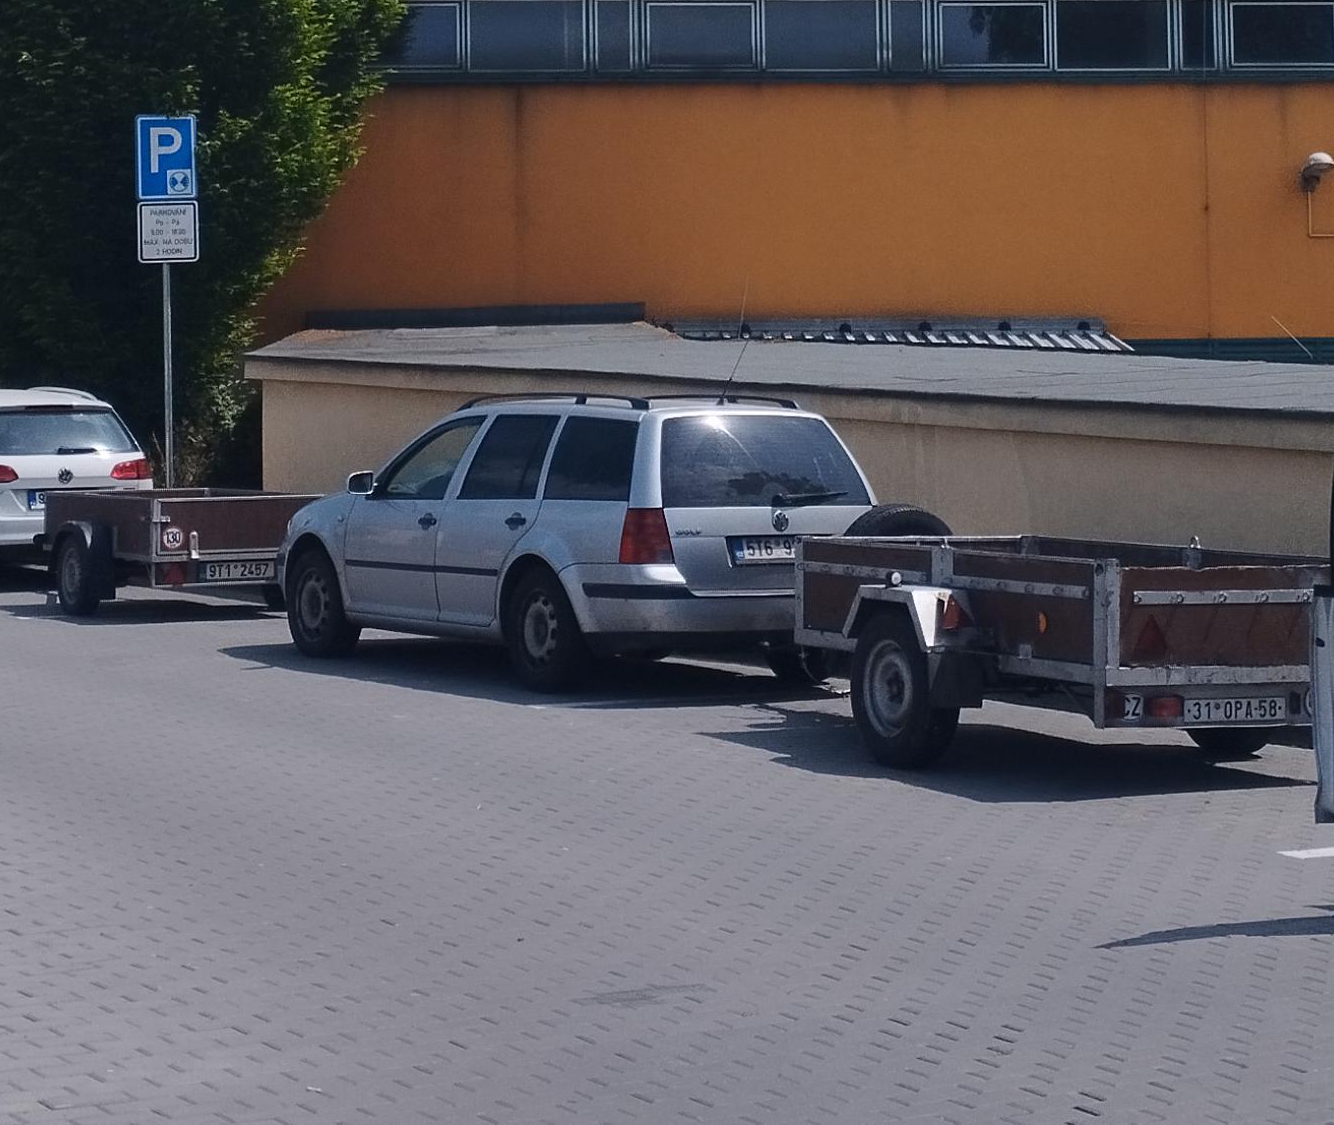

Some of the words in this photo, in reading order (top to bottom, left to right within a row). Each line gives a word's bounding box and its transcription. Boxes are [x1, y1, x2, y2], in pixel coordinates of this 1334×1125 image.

[150, 127, 182, 173] P
[149, 208, 186, 216] PARKOVÁNÍ
[162, 238, 173, 246] NA
[162, 247, 183, 255] HODIN
[166, 531, 181, 544] 130
[747, 540, 774, 557] 5T6
[209, 564, 231, 578] 9T1
[240, 562, 269, 577] 2457
[1193, 701, 1211, 720] 31
